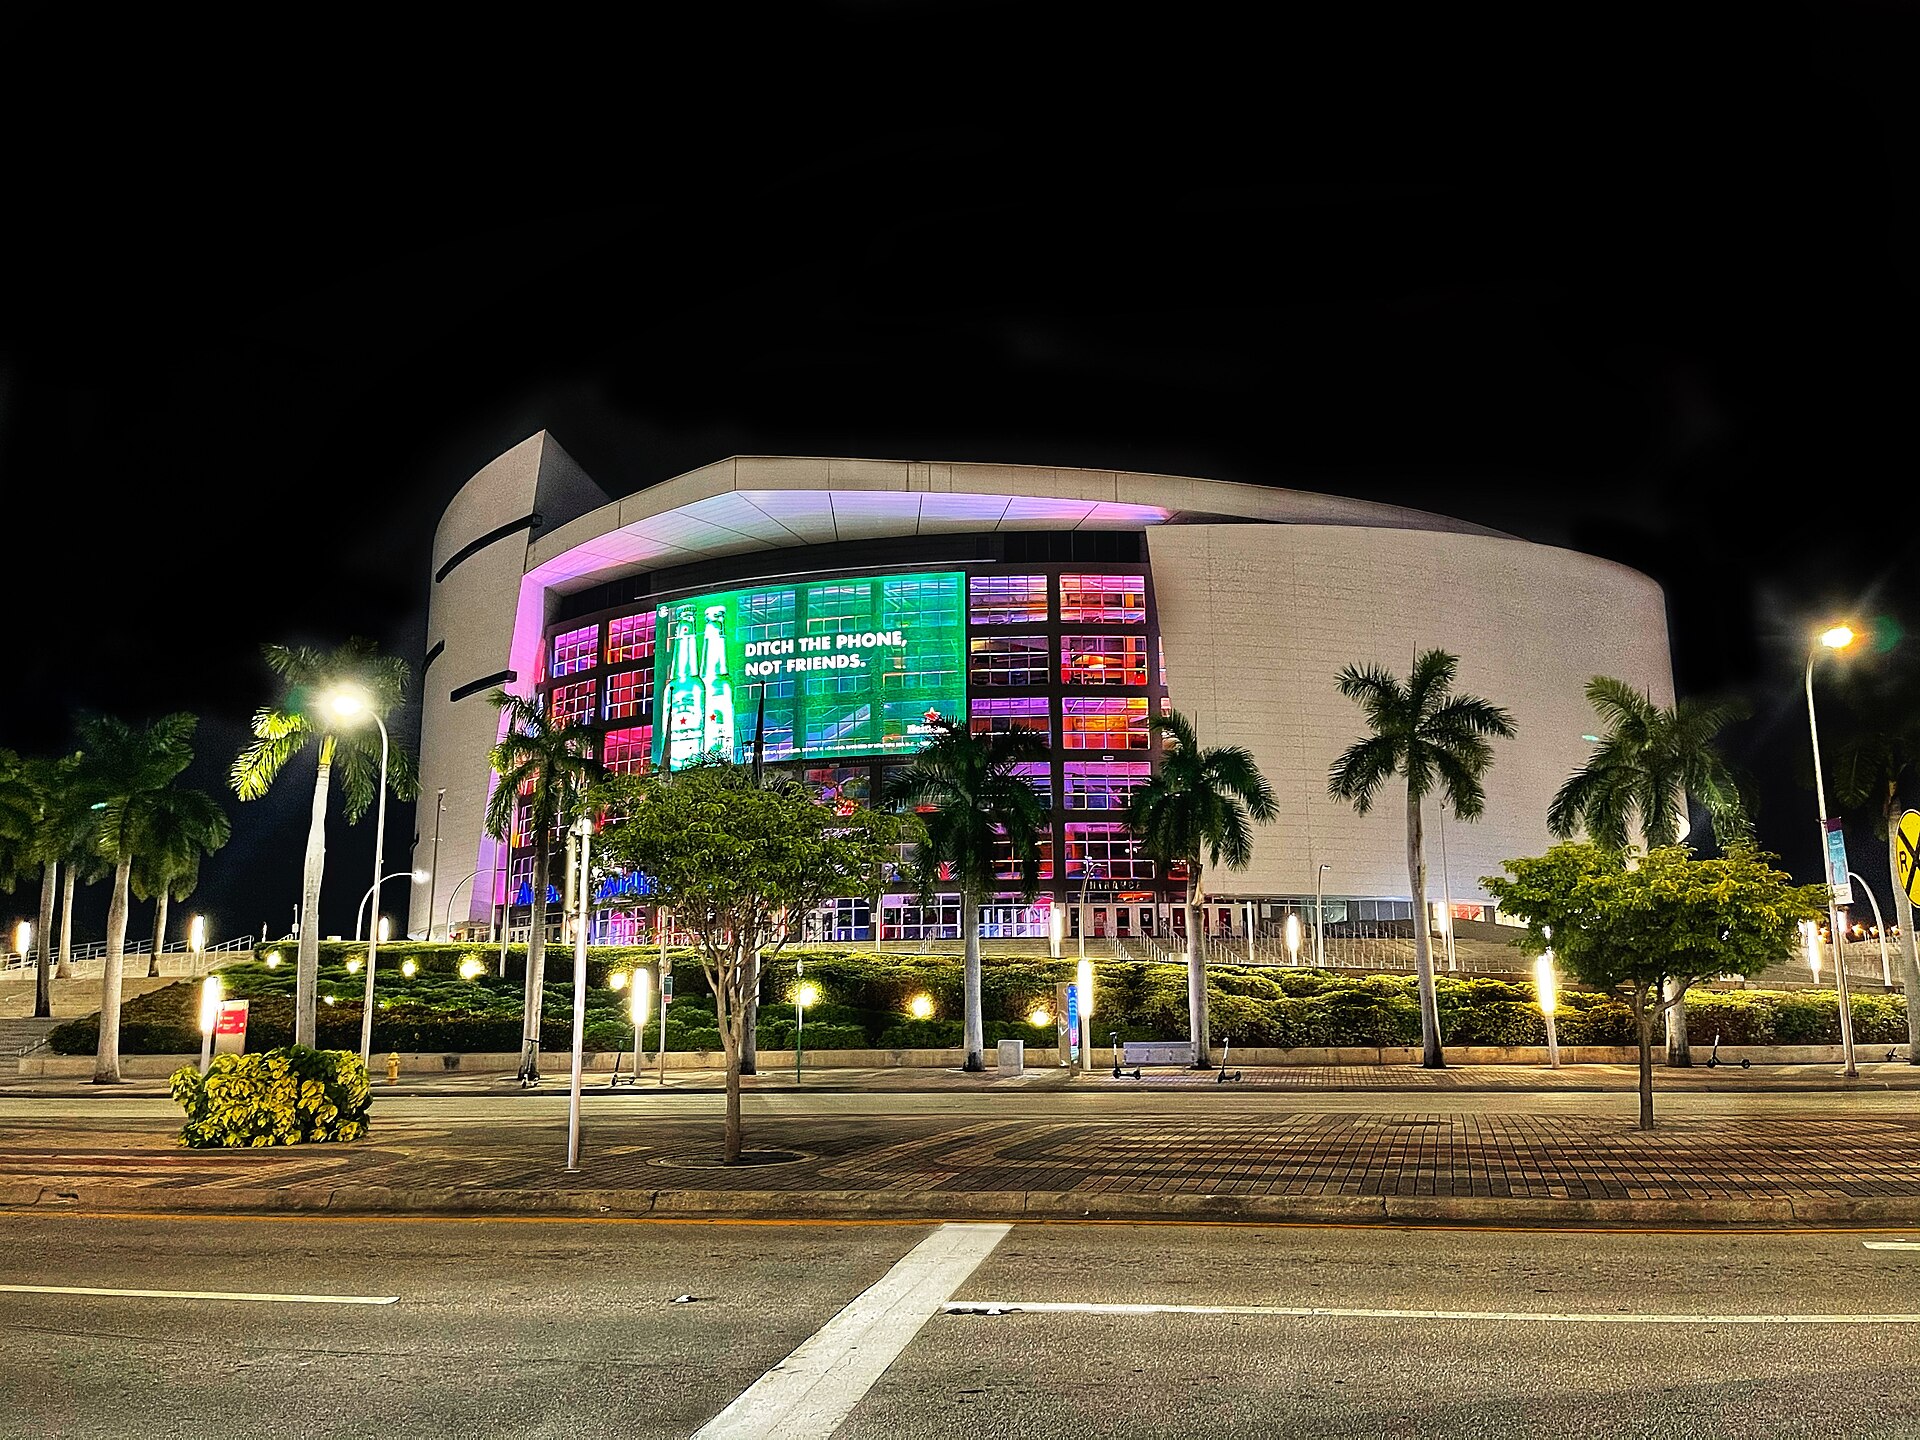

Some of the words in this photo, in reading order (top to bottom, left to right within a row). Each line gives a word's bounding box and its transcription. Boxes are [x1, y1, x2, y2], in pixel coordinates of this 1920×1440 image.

[745, 639, 794, 657] DITCH
[798, 636, 831, 652] THE
[836, 630, 907, 649] PHONE,
[745, 660, 782, 676] NOT
[786, 653, 867, 673] FRIENDS.
[1899, 851, 1908, 873] R
